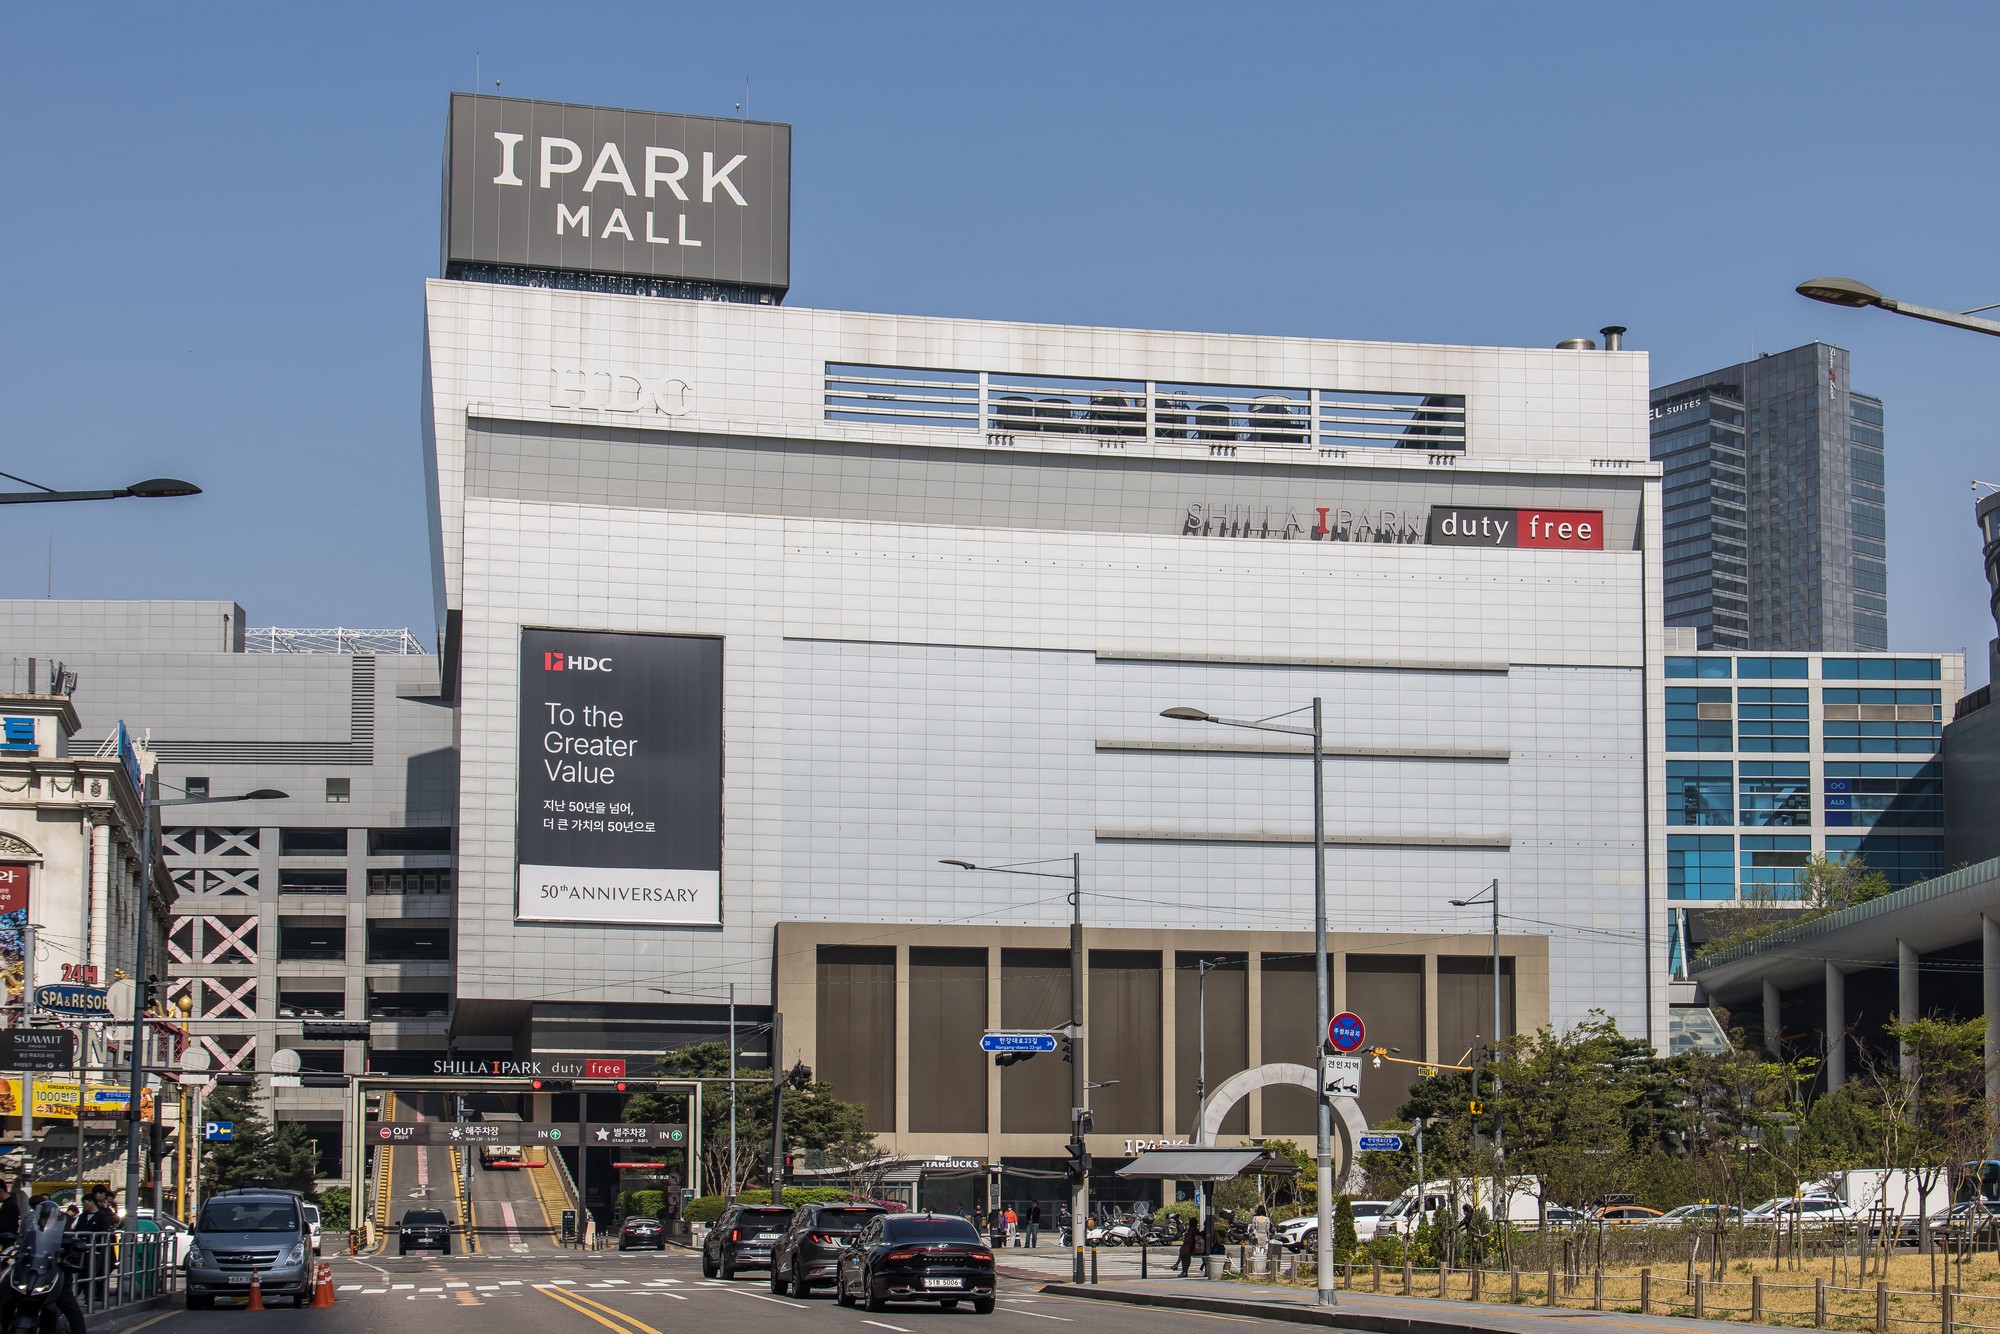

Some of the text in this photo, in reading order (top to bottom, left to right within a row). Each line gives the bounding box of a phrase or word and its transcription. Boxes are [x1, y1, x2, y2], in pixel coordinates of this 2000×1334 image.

[493, 131, 748, 207] IPARK
[556, 203, 702, 247] MALL
[550, 366, 694, 416] HDC
[1666, 399, 1701, 416] SUITES
[1186, 501, 1304, 534] SHILLA
[1441, 511, 1509, 539] duty
[1529, 515, 1592, 540] free
[568, 655, 613, 672] HDC
[544, 701, 624, 729] To the
[543, 730, 638, 757] Greater
[543, 758, 615, 785] Value
[543, 799, 634, 816] 지난 50년을 넘어,
[543, 817, 656, 833] 더 큰 가치의 50년으로
[61, 963, 98, 984] 24H
[13, 1034, 63, 1044] SUMMIT
[433, 1060, 488, 1074] SHILLA
[551, 1062, 583, 1075] duty
[591, 1063, 620, 1074] free
[1327, 1060, 1359, 1070] 견인지역
[206, 1122, 219, 1139] P
[393, 1127, 415, 1135] OUT
[537, 1130, 548, 1138] IN
[613, 1127, 647, 1138] 별주차장
[659, 1131, 670, 1139] IN
